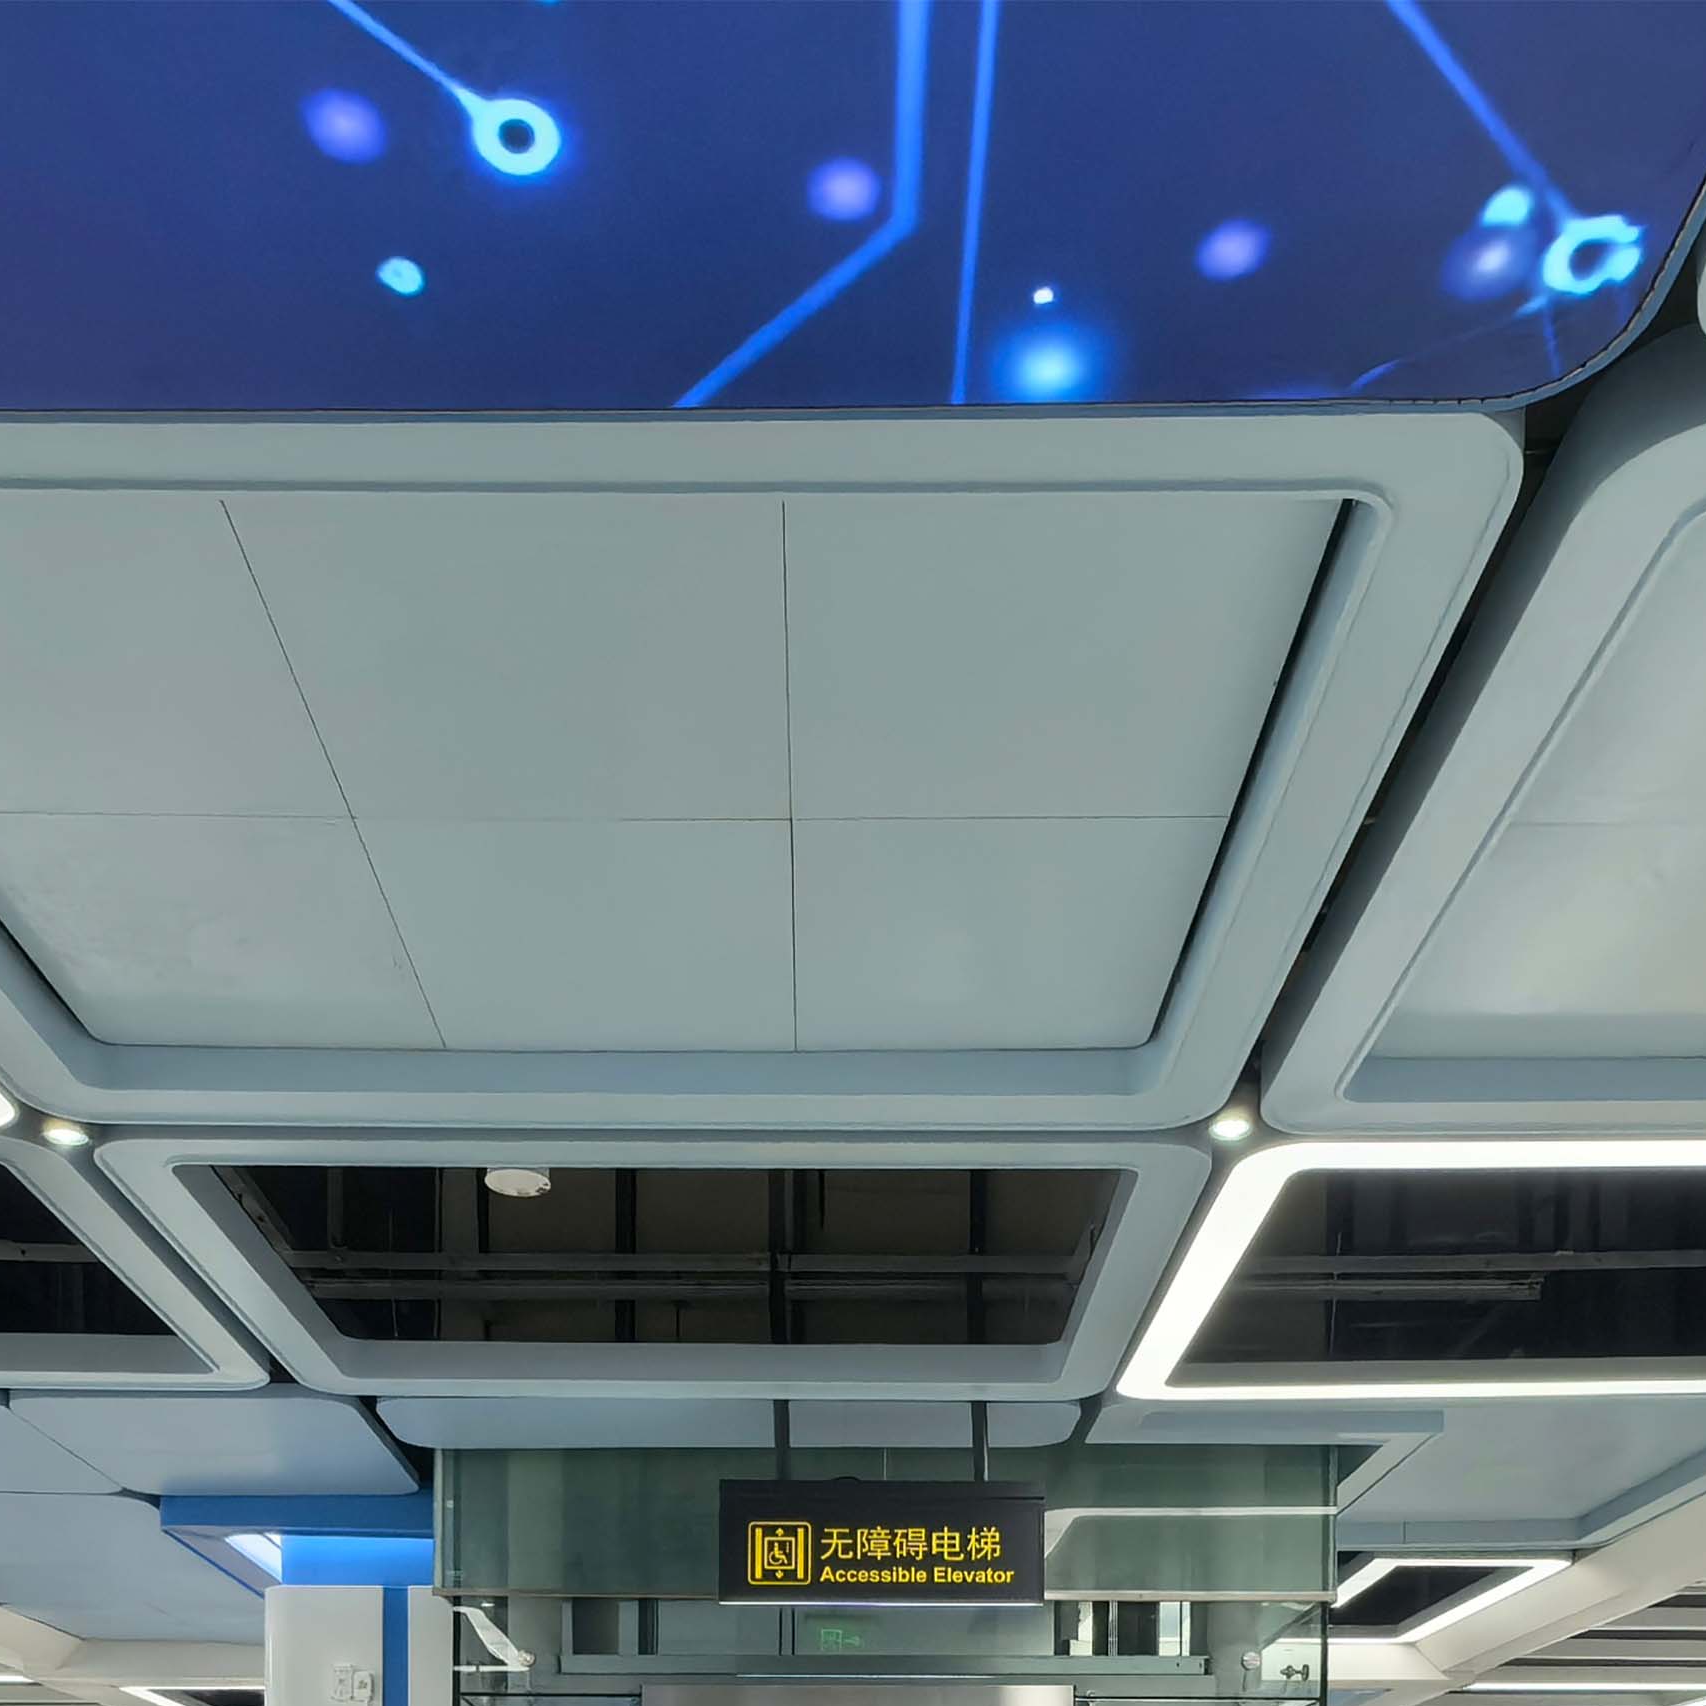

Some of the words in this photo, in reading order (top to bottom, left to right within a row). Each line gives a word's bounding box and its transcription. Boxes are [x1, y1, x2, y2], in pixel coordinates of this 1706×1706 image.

[820, 1526, 1001, 1561] 无障碍电梯
[820, 1566, 927, 1583] Accessible
[933, 1566, 1015, 1583] Elevator
